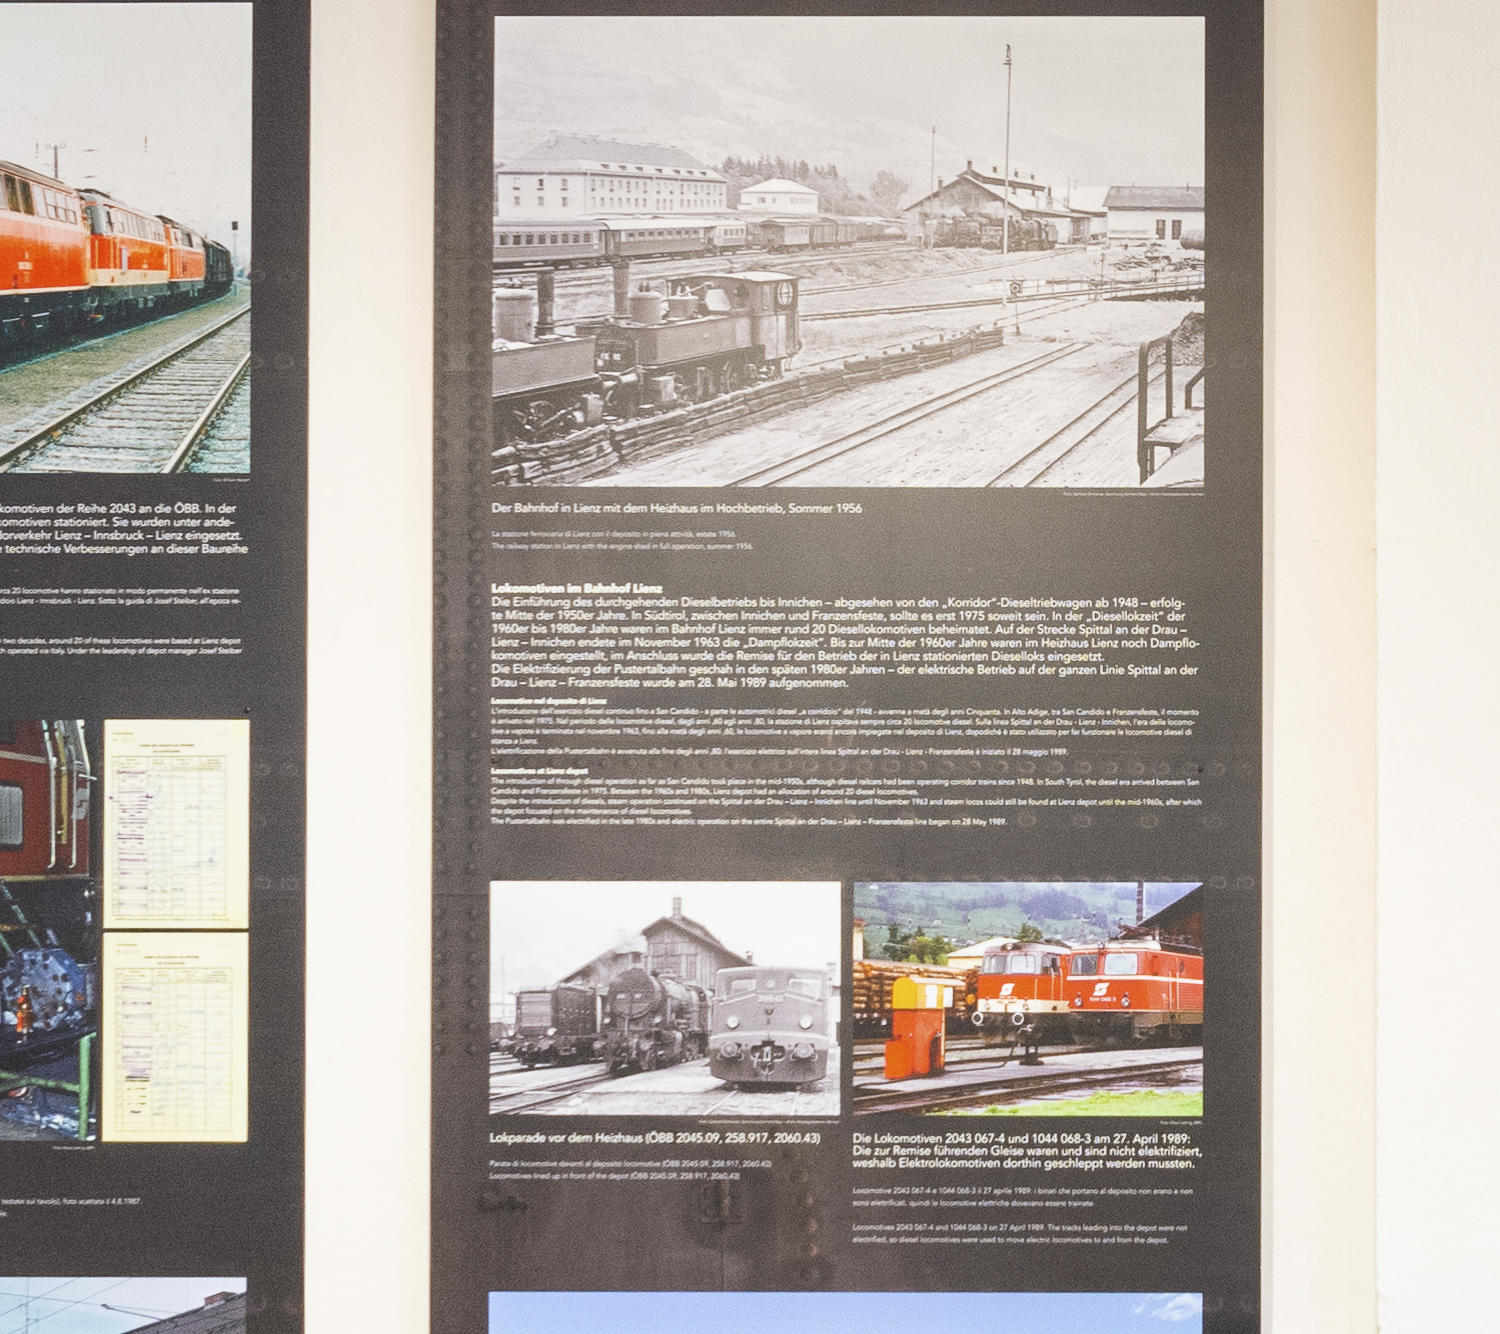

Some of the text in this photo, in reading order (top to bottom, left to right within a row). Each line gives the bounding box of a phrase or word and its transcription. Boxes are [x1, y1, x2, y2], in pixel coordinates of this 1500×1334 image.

[492, 502, 512, 513] Der
[514, 502, 559, 513] Bahnhof
[561, 502, 571, 513] in
[574, 502, 601, 513] Lienz
[603, 502, 621, 513] mit
[623, 502, 648, 513] dem
[650, 502, 698, 513] Heizhaus
[700, 502, 714, 513] im
[788, 503, 834, 514] Sommer
[836, 503, 862, 514] 1956
[492, 583, 663, 594] Lokomotiven im Bahnhof Lienz
[490, 1131, 546, 1145] Lokparade
[548, 1134, 566, 1143] vor
[568, 1132, 593, 1143] dem
[595, 1132, 644, 1143] Heizhaus
[645, 1130, 674, 1146] (ÖBB
[774, 1132, 820, 1146] 2060.43)
[853, 1132, 872, 1144] Die
[874, 1132, 942, 1144] Lokomotiven
[945, 1132, 972, 1144] 2043
[974, 1132, 1005, 1144] 067-4
[1008, 1132, 1029, 1144] und
[1032, 1132, 1058, 1144] 1044
[1060, 1132, 1091, 1144] 068-3
[1094, 1135, 1110, 1144] am
[1132, 1133, 1158, 1146] April
